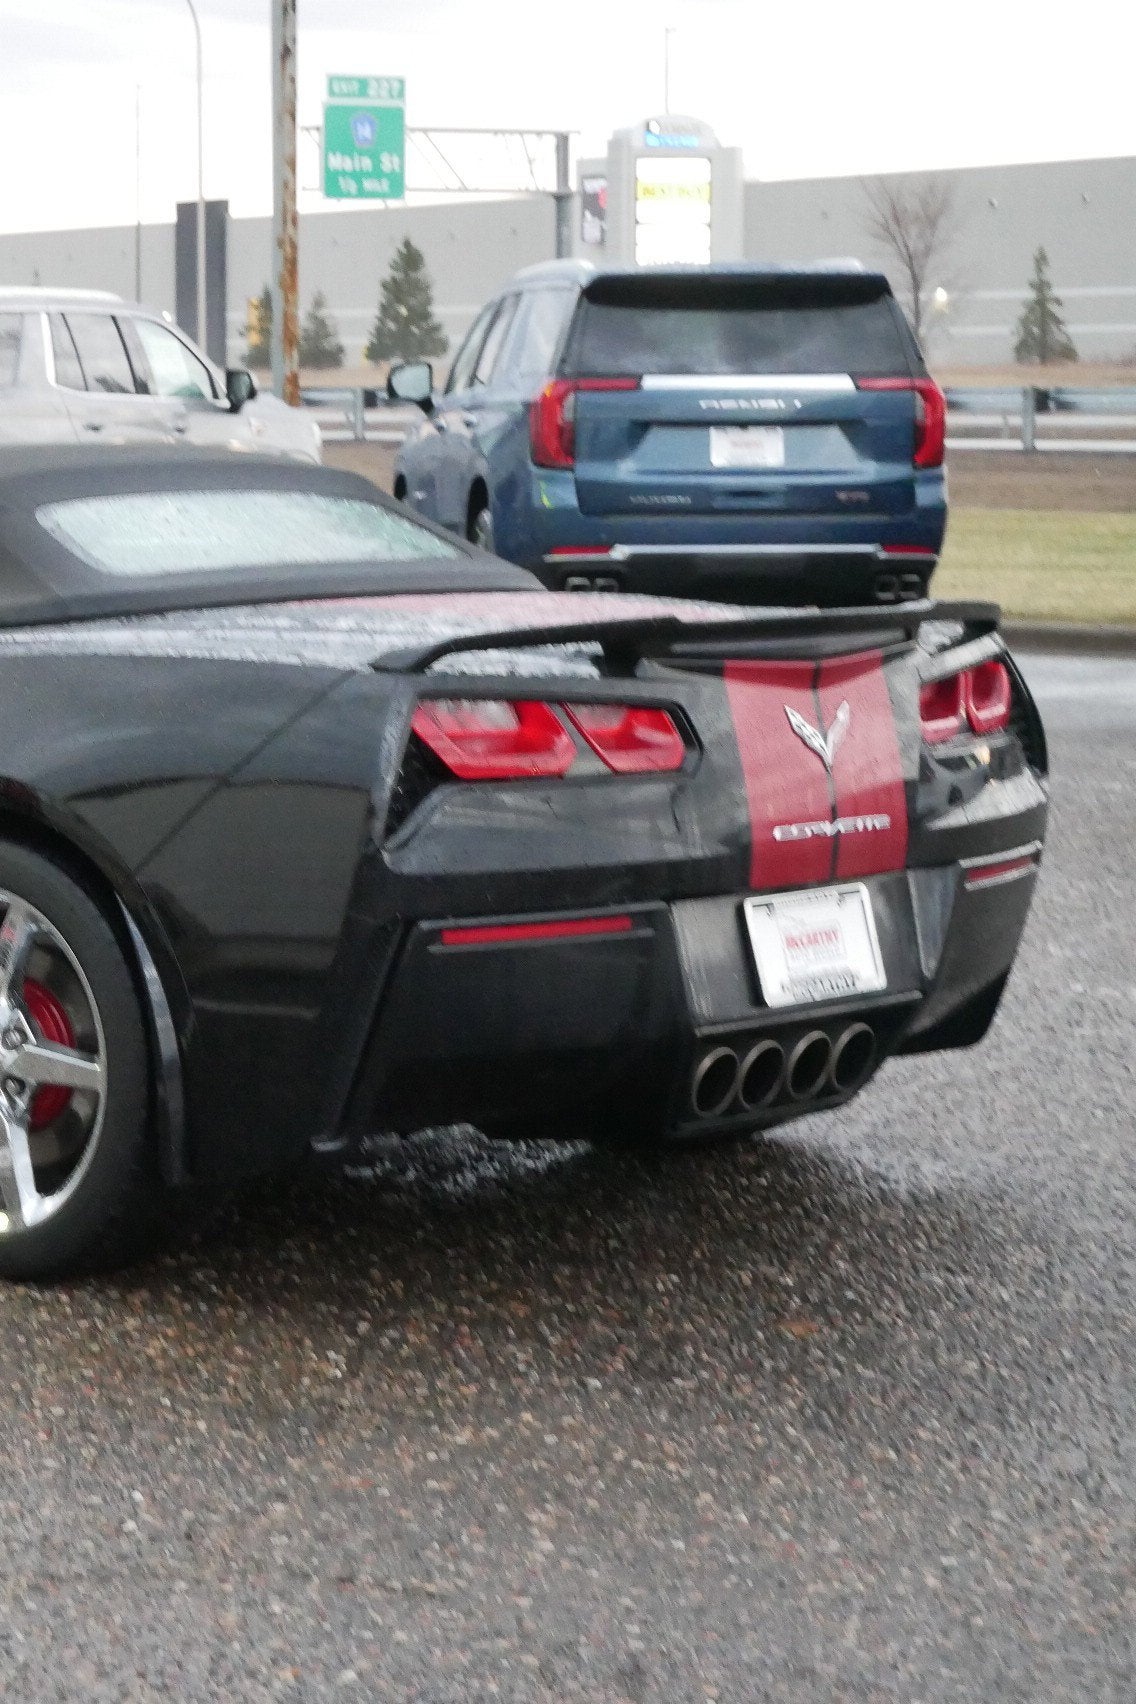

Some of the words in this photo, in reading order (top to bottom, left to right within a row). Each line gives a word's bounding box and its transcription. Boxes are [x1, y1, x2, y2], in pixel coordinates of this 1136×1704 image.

[327, 152, 372, 172] Main
[379, 152, 401, 173] St
[772, 813, 891, 842] CORVETTE
